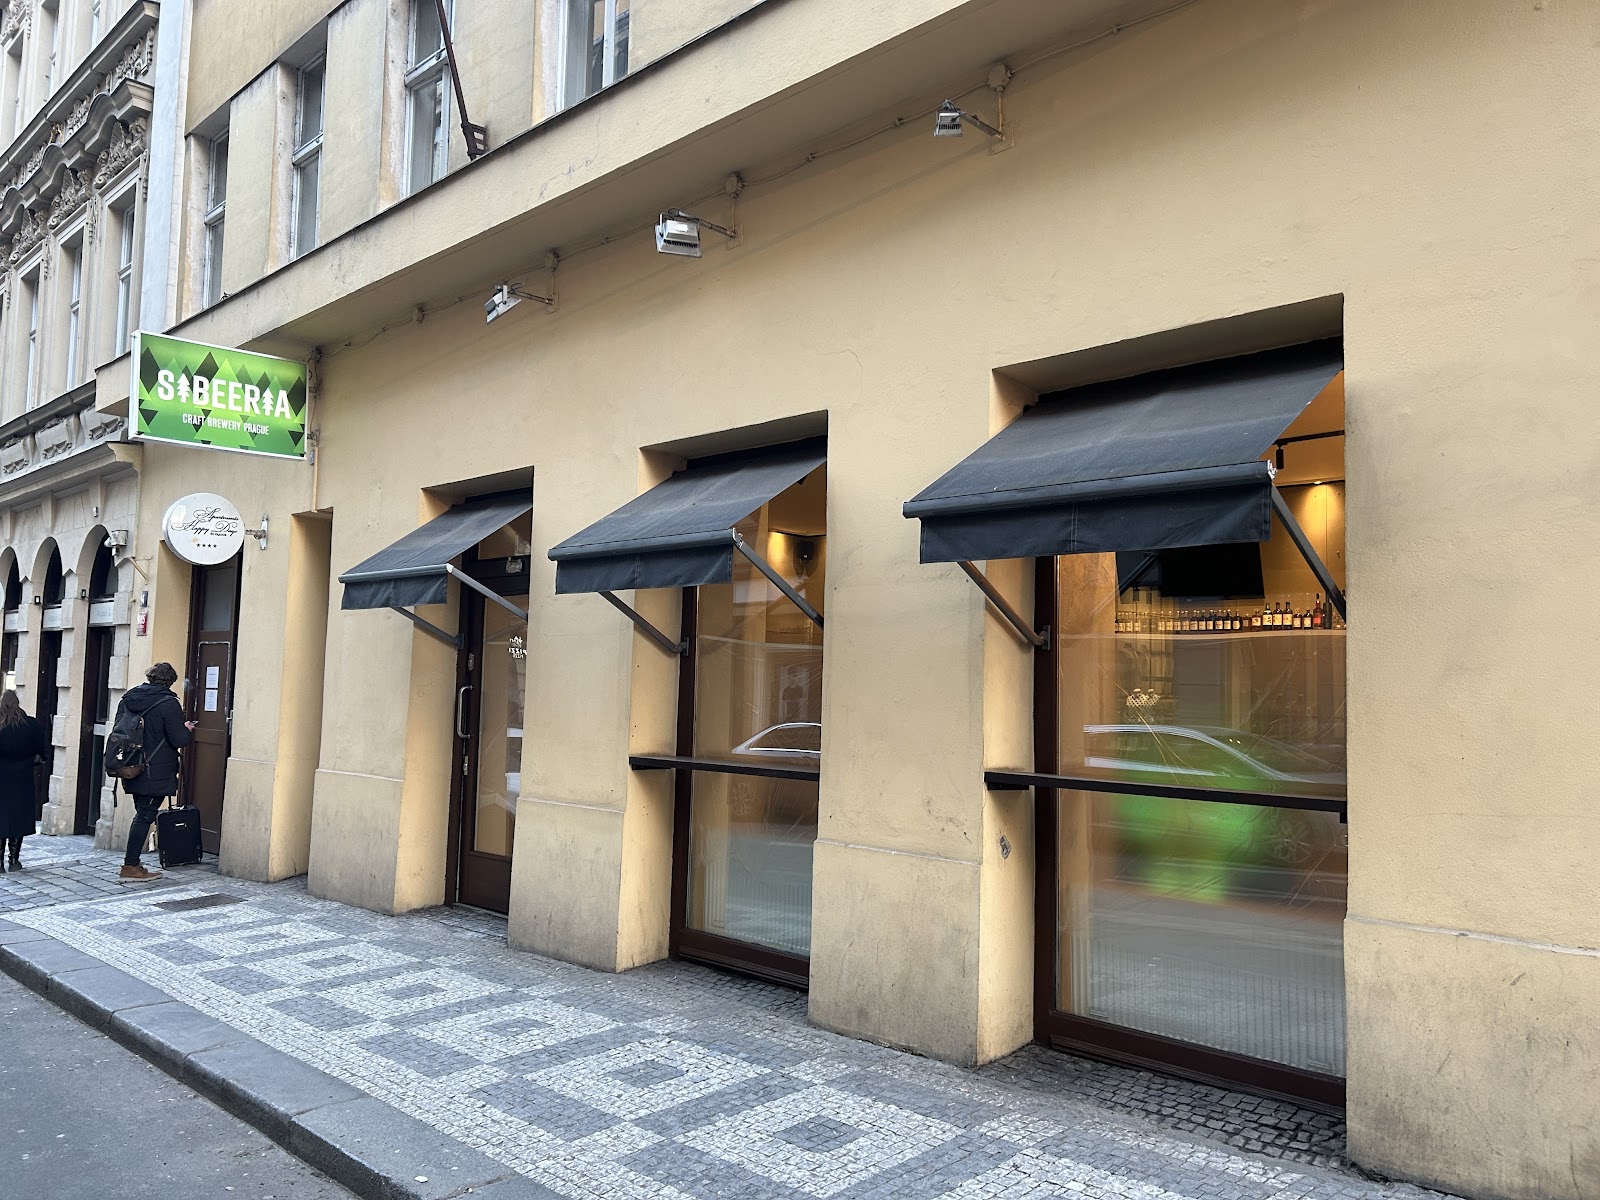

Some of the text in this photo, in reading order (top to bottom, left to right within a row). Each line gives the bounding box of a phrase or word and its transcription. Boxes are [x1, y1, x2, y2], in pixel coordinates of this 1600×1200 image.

[182, 413, 269, 435] CRAFT BREWERY PRAGUE
[171, 520, 210, 535] Happy
